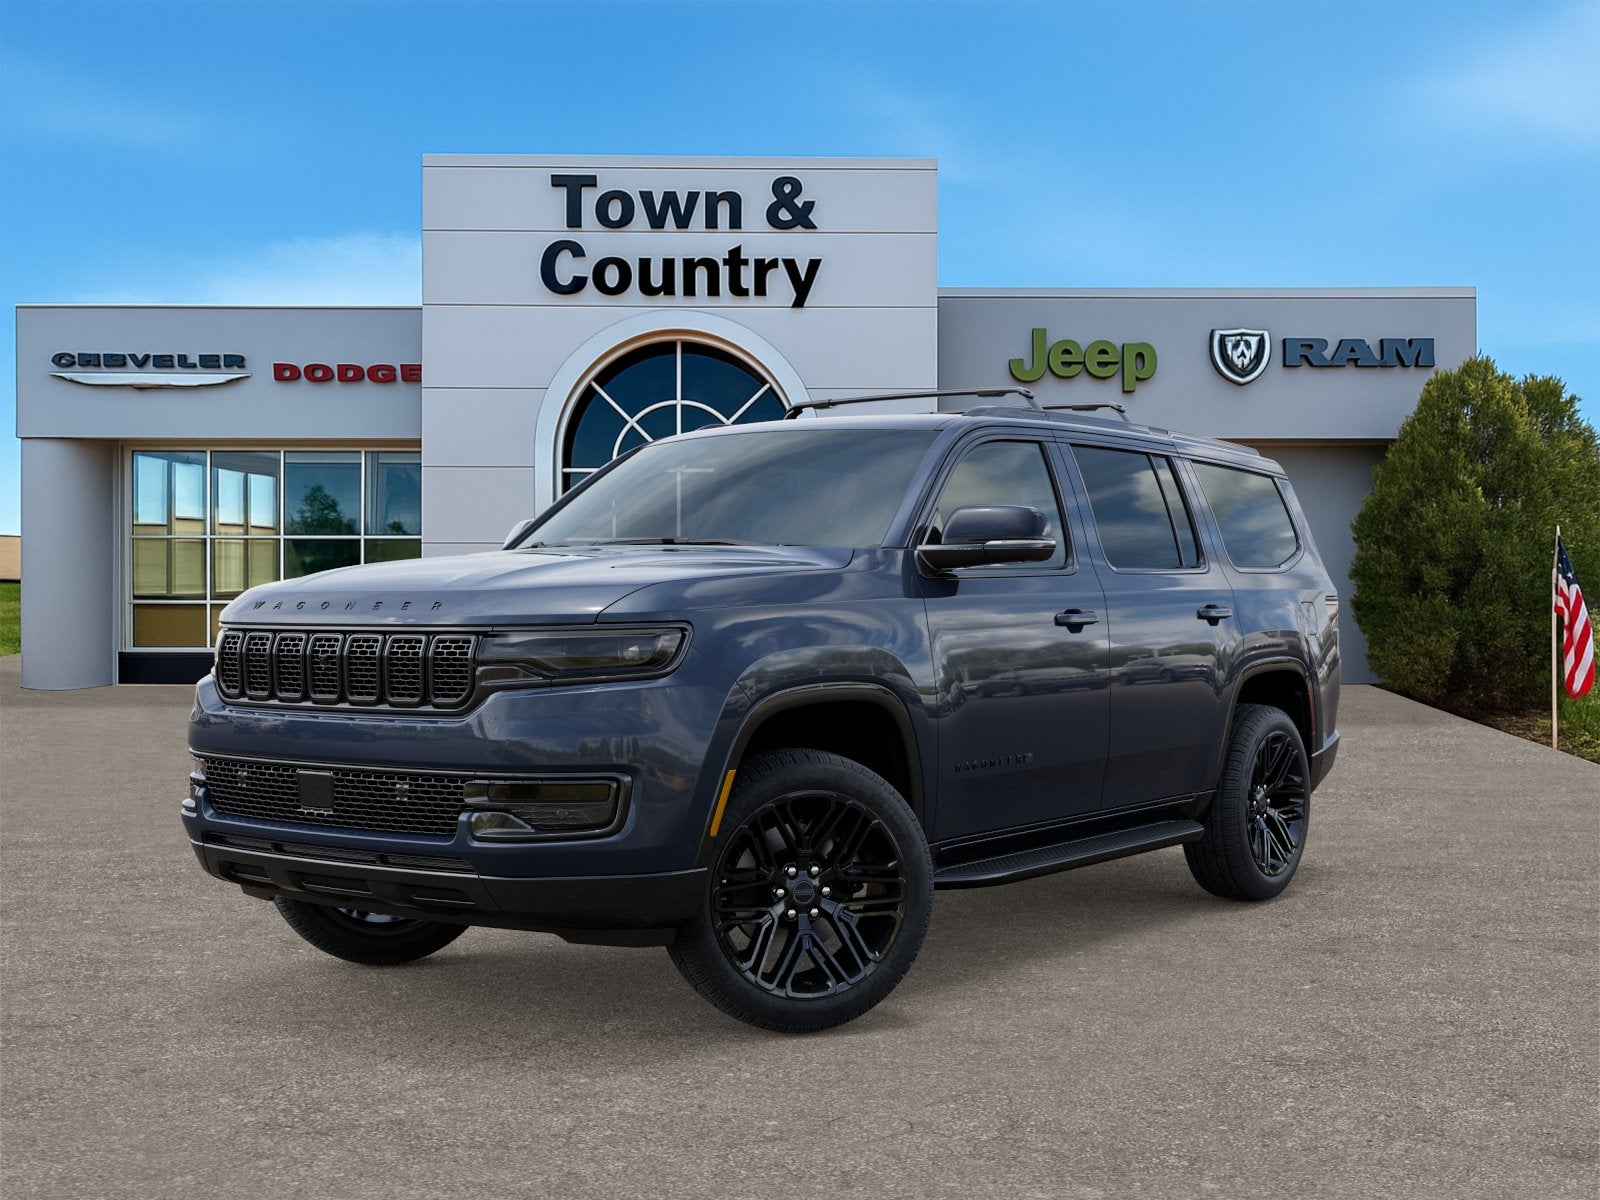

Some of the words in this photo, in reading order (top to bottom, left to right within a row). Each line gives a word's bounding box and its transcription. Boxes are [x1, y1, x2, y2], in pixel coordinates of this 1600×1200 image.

[550, 174, 743, 230] Town
[766, 175, 818, 230] &
[540, 239, 822, 309] Country
[272, 362, 422, 383] DODGE
[1009, 327, 1158, 393] Jeep
[1283, 337, 1436, 368] RAM
[252, 600, 443, 612] WAGONEER
